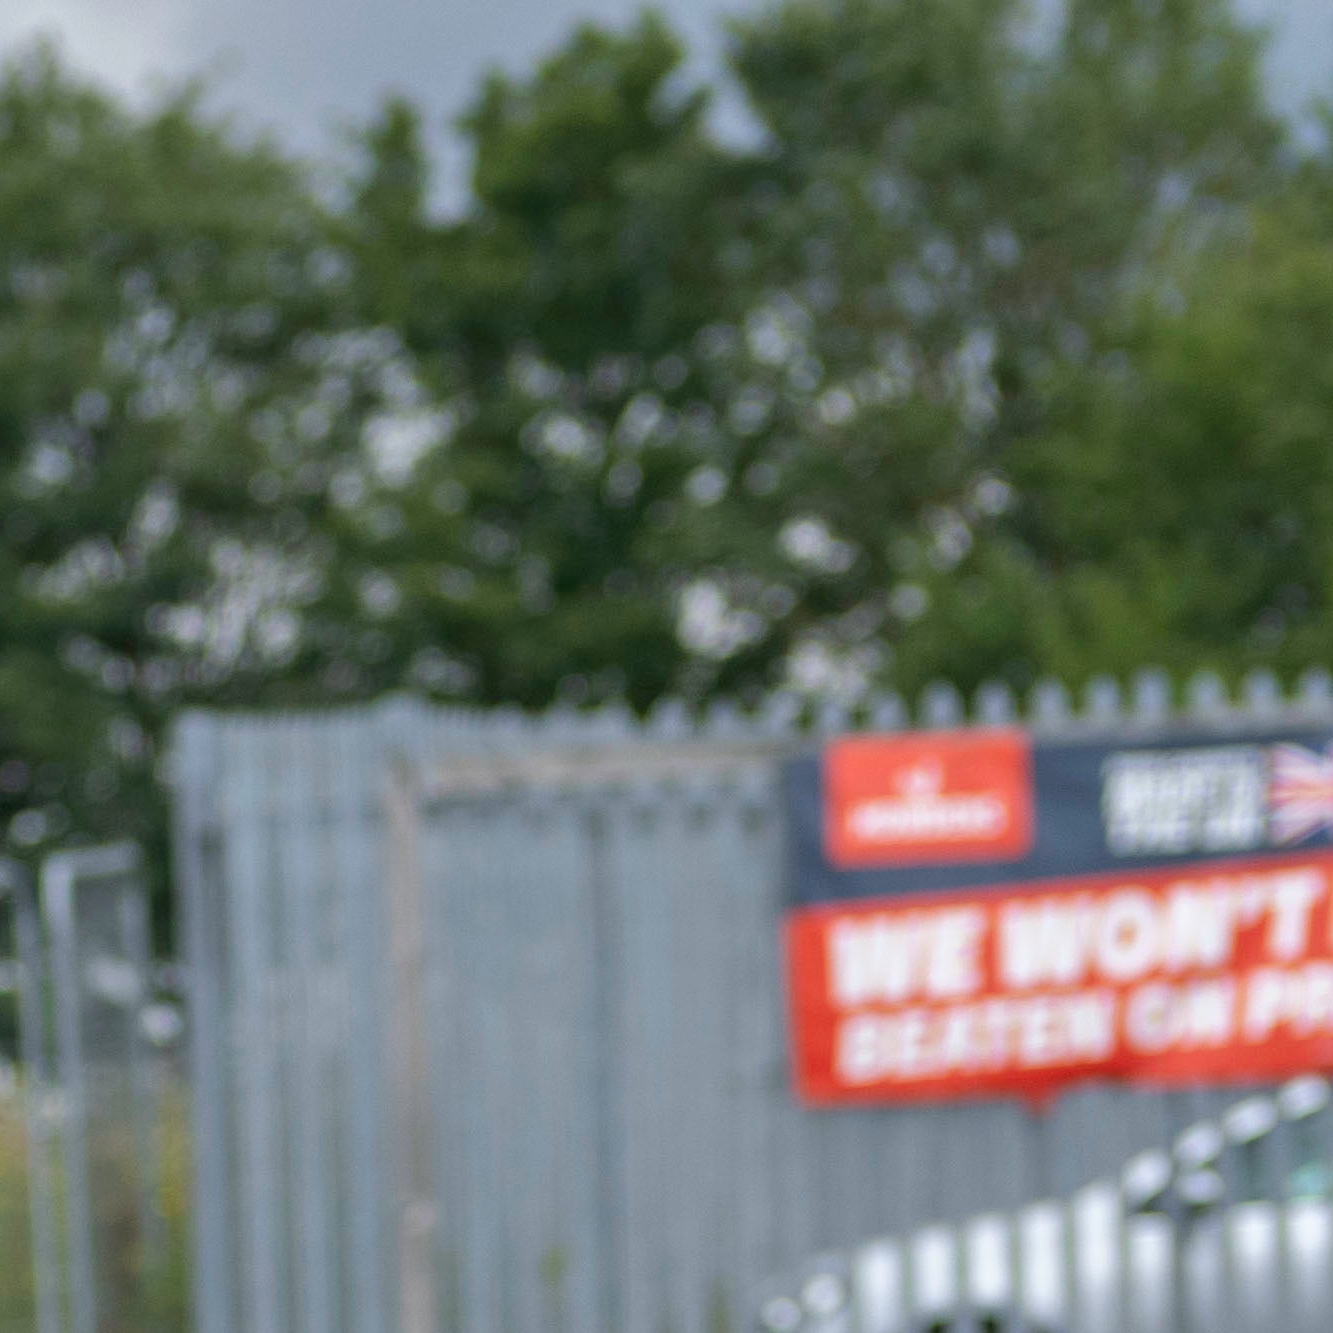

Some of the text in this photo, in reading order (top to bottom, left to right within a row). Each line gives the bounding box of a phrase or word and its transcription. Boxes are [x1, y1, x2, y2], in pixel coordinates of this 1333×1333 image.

[829, 868, 1325, 1007] WE WON'T
[837, 990, 1115, 1086] BEATEN
[1125, 976, 1234, 1055] ON
